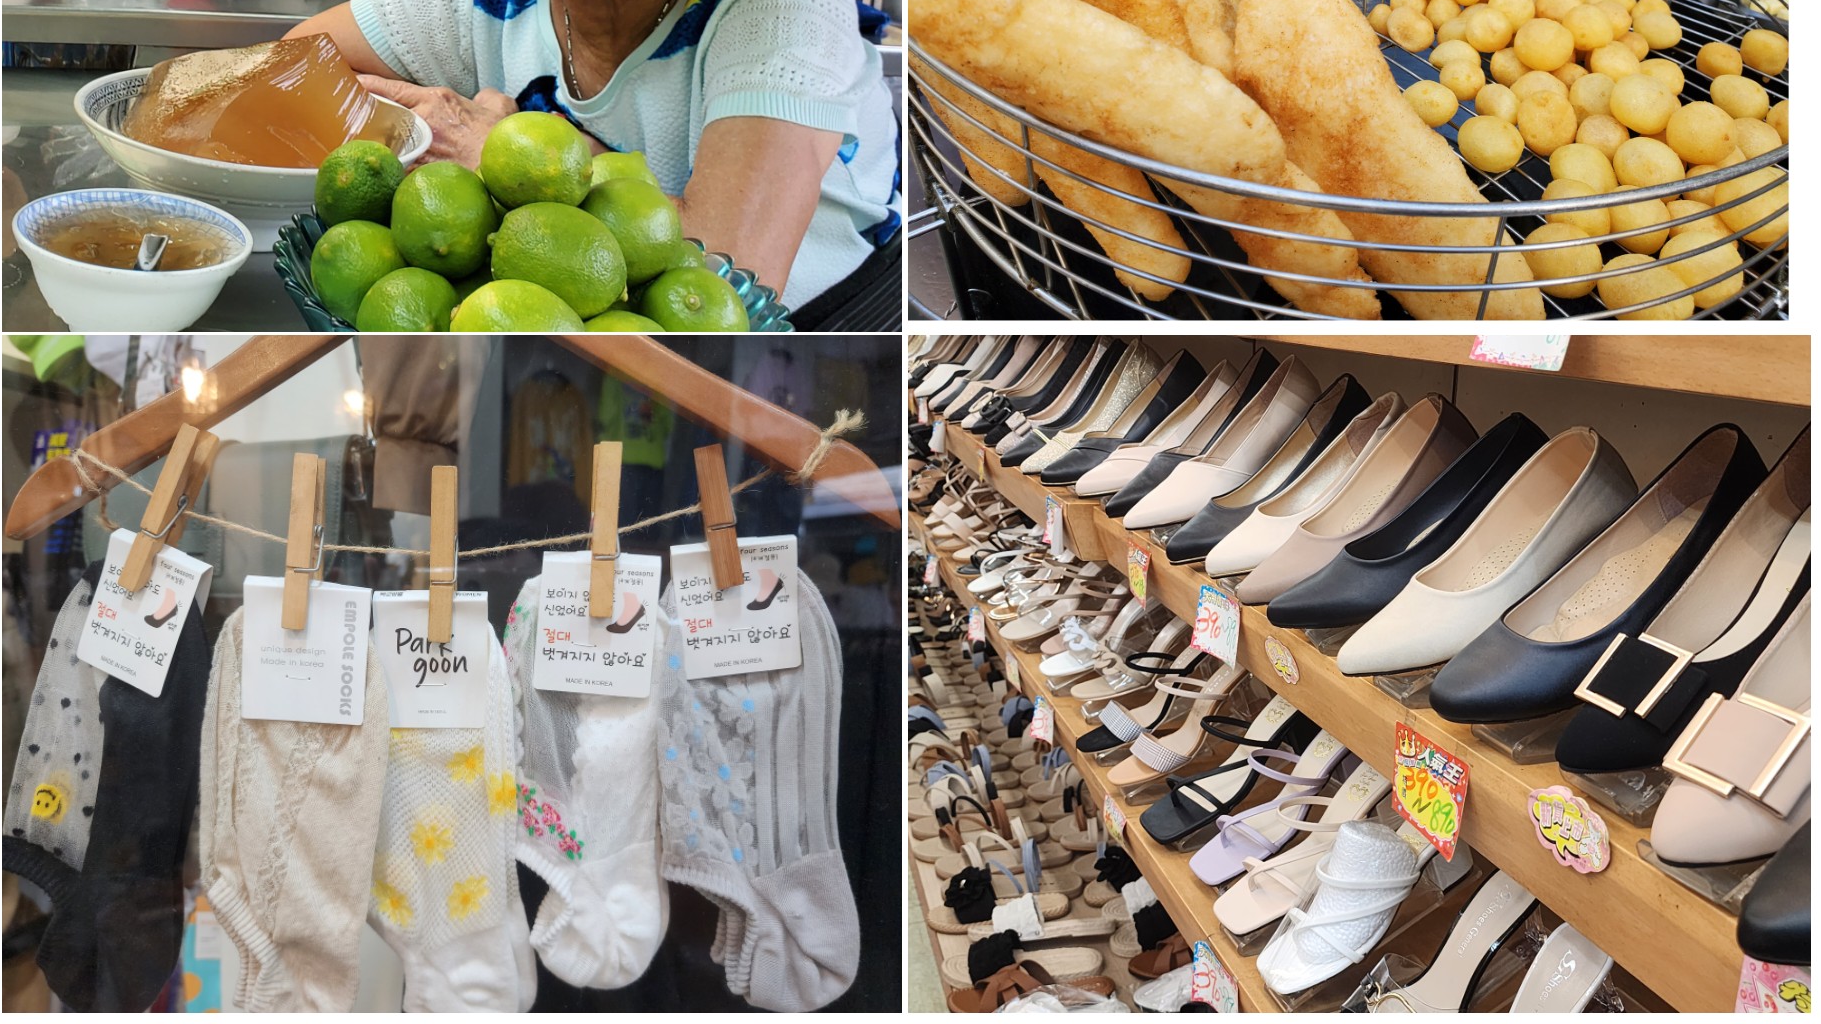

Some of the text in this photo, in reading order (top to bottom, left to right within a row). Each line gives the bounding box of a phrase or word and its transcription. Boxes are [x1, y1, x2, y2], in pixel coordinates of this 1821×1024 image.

[760, 544, 789, 553] seasons
[679, 576, 712, 590] 보이지
[546, 588, 578, 599] 보이지
[97, 601, 118, 620] 절대
[543, 628, 571, 644] 절대
[684, 618, 713, 634] 절대
[686, 623, 792, 651] 벗겨지지 않아요
[296, 646, 326, 657] design
[542, 647, 647, 668] 벗겨지지 않아요
[100, 655, 115, 666] MADE
[120, 664, 137, 677] KOREA
[413, 655, 468, 688] goon
[714, 660, 732, 668] MADE
[740, 657, 763, 665] KOREA
[339, 664, 354, 717] SOCKS
[1417, 746, 1465, 786] 人氣王
[1405, 767, 1438, 800] 390
[1430, 799, 1455, 834] 890
